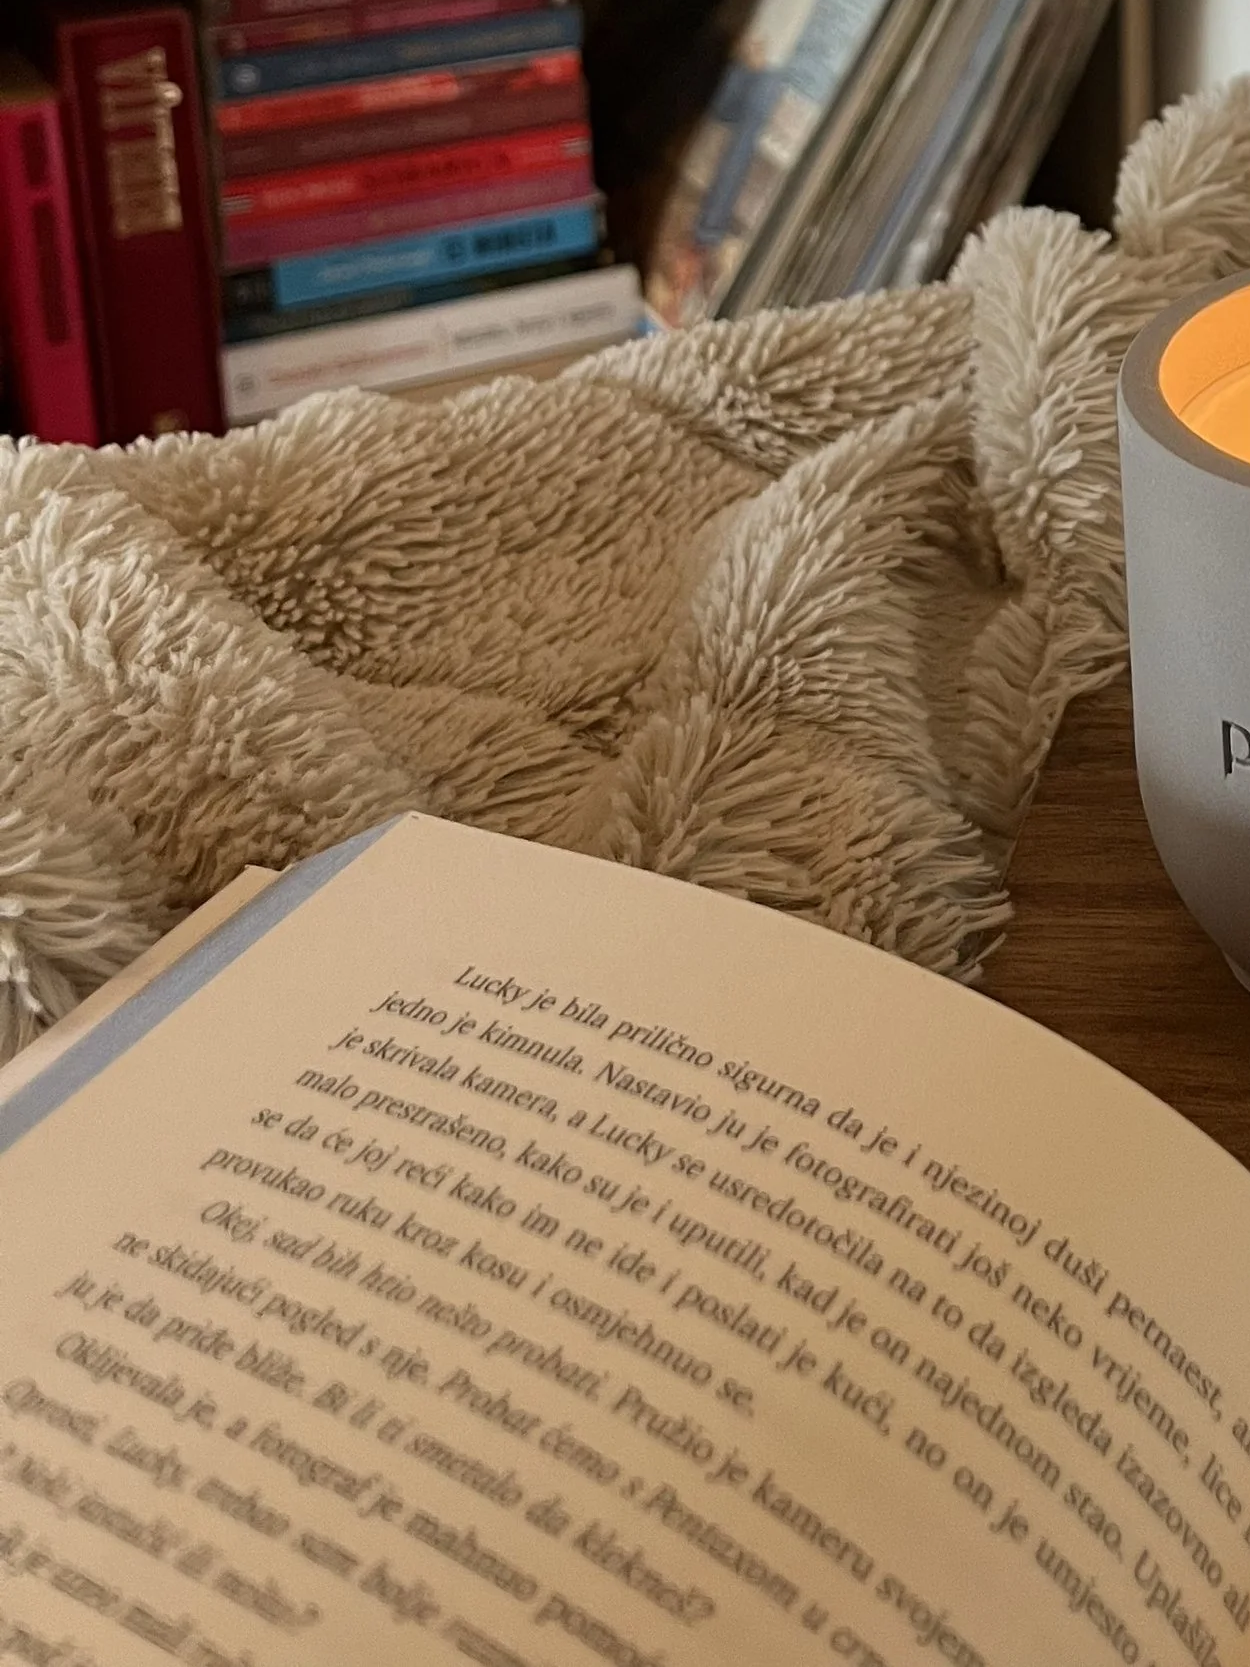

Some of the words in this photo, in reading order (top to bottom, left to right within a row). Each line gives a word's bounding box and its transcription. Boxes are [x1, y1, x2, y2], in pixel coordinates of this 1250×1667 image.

[54, 1272, 96, 1300] ju
[84, 1289, 124, 1310] je
[124, 1298, 161, 1328] da
[113, 1233, 150, 1257] ne
[148, 1245, 265, 1305] skidajući
[256, 1294, 366, 1350] pogled
[358, 1338, 380, 1357] s
[379, 1347, 429, 1385] nje.
[437, 1369, 542, 1439] Probat
[620, 1478, 643, 1498] s
[200, 1149, 326, 1202] provukao
[325, 1193, 393, 1230] ruku
[393, 1212, 459, 1257] kroz
[458, 1240, 529, 1290] kosu
[530, 1273, 553, 1299] i
[549, 1289, 713, 1387] osmjehnuo
[716, 1379, 754, 1417] se.
[251, 1109, 283, 1129] se
[284, 1115, 319, 1142] da
[321, 1129, 354, 1154] će
[344, 1139, 399, 1173] joj
[393, 1159, 453, 1190] reći
[448, 1173, 517, 1219] kako
[519, 1204, 560, 1239] im
[564, 1229, 604, 1257] ne
[606, 1243, 656, 1284] ide
[659, 1270, 681, 1295] i
[672, 1285, 787, 1355] poslati
[775, 1339, 818, 1376] je
[820, 1361, 895, 1437] kući,
[904, 1427, 947, 1470] no
[952, 1467, 994, 1513] on
[989, 1500, 1029, 1543] je
[1034, 1538, 1139, 1665] umjesto
[295, 1070, 359, 1100] malo
[352, 1090, 506, 1161] prestrašeno,
[514, 1140, 583, 1185] kako
[582, 1176, 620, 1202] su
[610, 1185, 650, 1215] je
[651, 1200, 672, 1224] i
[668, 1213, 771, 1282] uputili,
[775, 1262, 839, 1315] kad
[826, 1299, 867, 1335] je
[870, 1328, 911, 1366] on
[912, 1357, 1061, 1491] najednom
[328, 1027, 364, 1050] je
[362, 1037, 460, 1082] skrivala
[459, 1065, 558, 1123] kamera,
[567, 1111, 587, 1129] a
[588, 1113, 675, 1166] Lucky
[671, 1155, 706, 1179] se
[708, 1170, 884, 1277] usredotočila
[887, 1268, 928, 1306] na
[931, 1295, 964, 1330] to
[967, 1321, 1007, 1363] da
[1009, 1348, 1112, 1458] izgleda
[1114, 1444, 1223, 1588] izazovno
[369, 991, 448, 1025] jedno
[440, 1012, 477, 1036] je
[477, 1020, 583, 1075] kimnula.
[593, 1061, 711, 1123] Nastavio
[706, 1110, 747, 1140] ju
[741, 1125, 779, 1155] je
[783, 1142, 962, 1257] fotografirati
[952, 1243, 1011, 1289] još
[1010, 1283, 1083, 1350] neko
[1092, 1345, 1190, 1468] vrijeme,
[1199, 1453, 1242, 1523] lice
[453, 966, 531, 1005] Lucky
[521, 989, 557, 1011] je
[559, 997, 609, 1030] bila
[607, 1021, 714, 1069] prilično
[717, 1061, 821, 1118] sigurna
[826, 1108, 864, 1140] da
[860, 1126, 899, 1156] je
[902, 1144, 922, 1168] i
[921, 1160, 1042, 1247] njezinoj
[1043, 1238, 1109, 1296] duši
[1104, 1291, 1222, 1422] petnaest,
[263, 1231, 323, 1261] sad
[311, 1242, 361, 1280] bih
[358, 1263, 416, 1304] htio
[416, 1295, 492, 1339] nešto
[611, 1385, 714, 1465] Pružio
[706, 1449, 750, 1488] je
[750, 1471, 875, 1584] kameru
